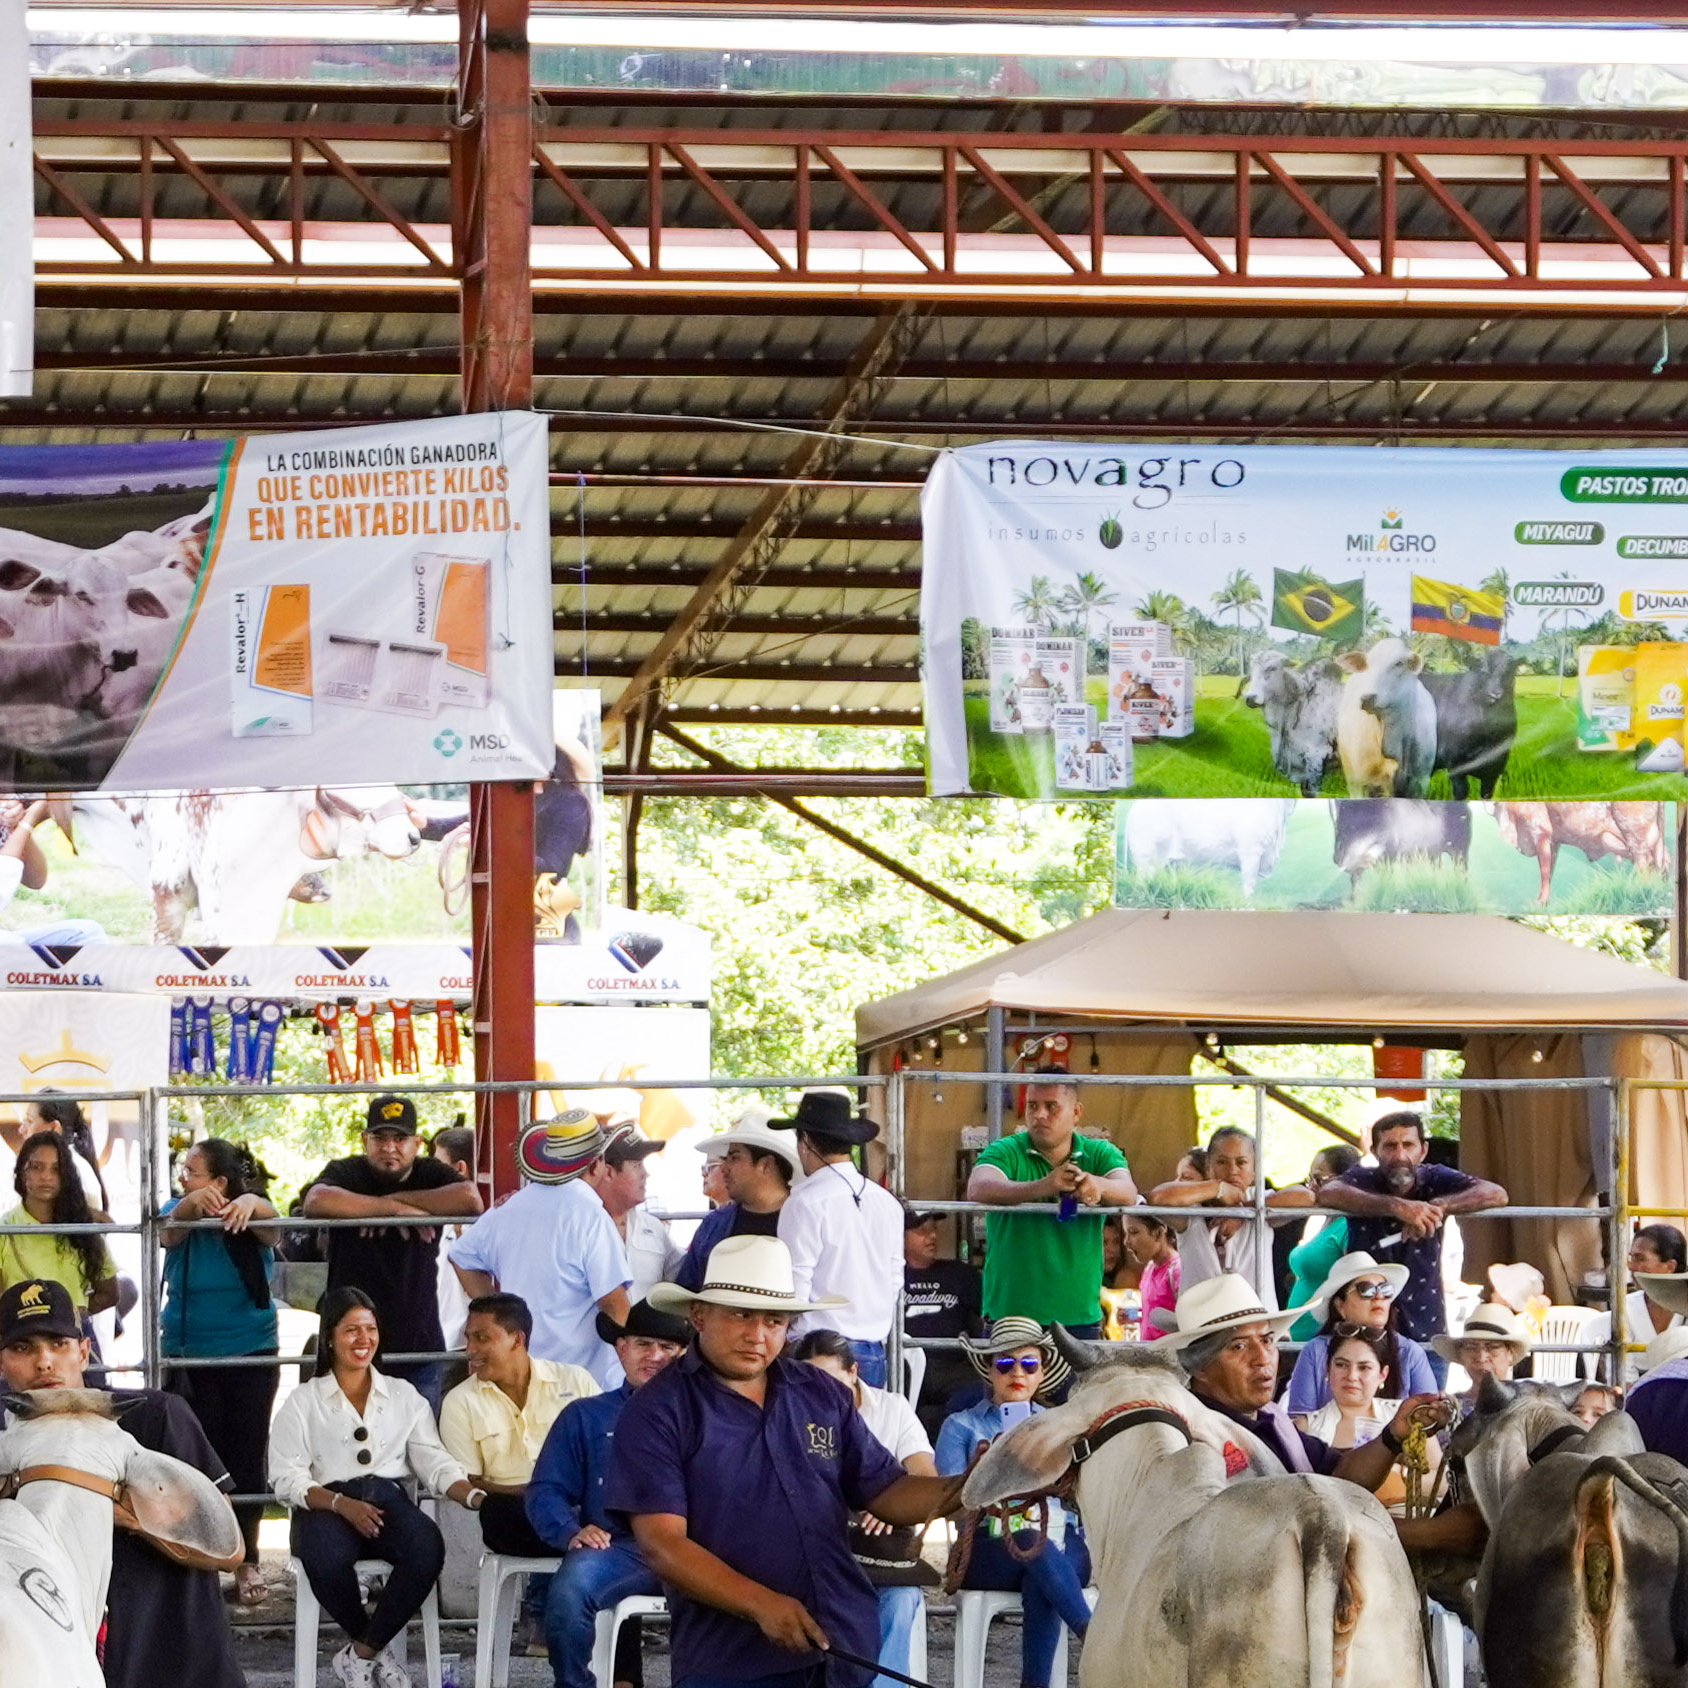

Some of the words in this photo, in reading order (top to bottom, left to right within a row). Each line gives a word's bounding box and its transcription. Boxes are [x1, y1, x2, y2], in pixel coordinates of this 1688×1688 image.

[267, 453, 287, 472] LA
[292, 443, 405, 471] COMBINACIÓN
[411, 442, 498, 465] GANADORA
[258, 475, 303, 504] QUE
[309, 468, 437, 500] CONVIERTE
[443, 464, 510, 495] KILOS
[987, 456, 1246, 510] novagro
[1576, 476, 1647, 496] PASTOS
[248, 506, 285, 541] EN
[295, 496, 522, 540] RENTABILIDAD.
[988, 521, 1086, 541] insumos
[1522, 524, 1595, 541] MIYAGUI
[1516, 582, 1602, 604] MARANDÚ
[469, 734, 510, 750] MSD
[6, 971, 80, 986] COLETMAX
[155, 975, 228, 988] COLETMAX
[295, 975, 366, 988] COLETMAX
[587, 978, 658, 990] COLETMAX
